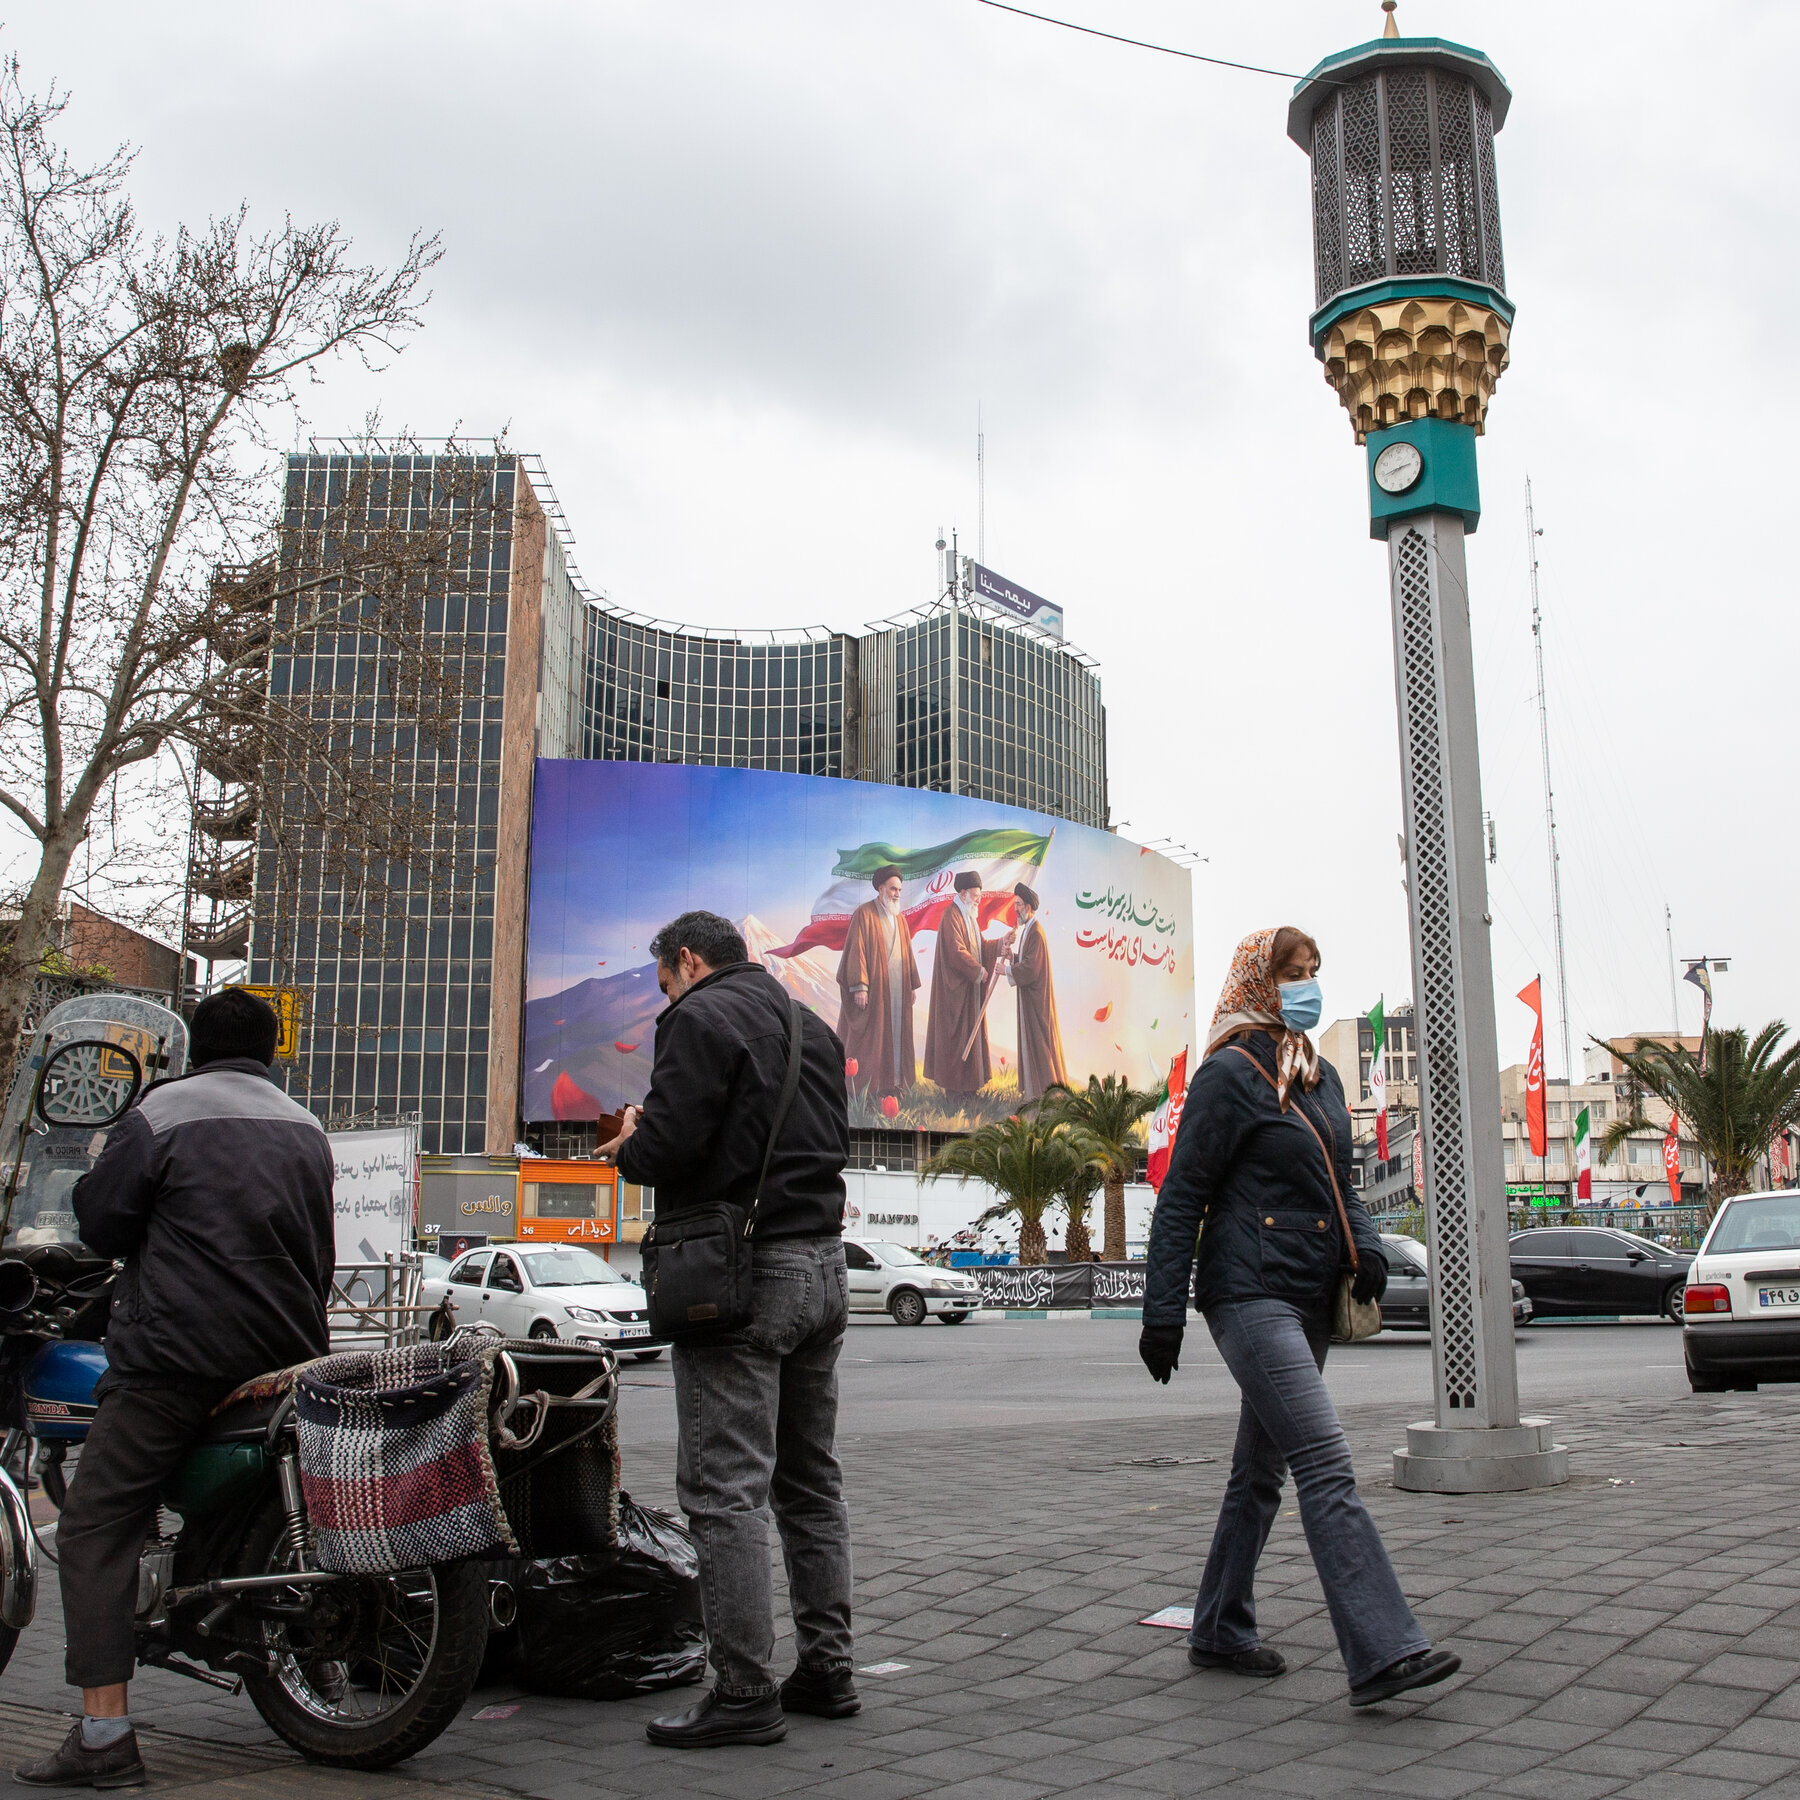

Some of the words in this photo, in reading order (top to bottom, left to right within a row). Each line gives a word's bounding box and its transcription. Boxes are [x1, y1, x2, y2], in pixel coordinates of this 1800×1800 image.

[980, 573, 1005, 597] سینا
[1005, 589, 1031, 613] بیمه
[1155, 916, 1176, 937] دست
[460, 1194, 513, 1217] والس
[424, 1224, 441, 1234] 37
[522, 1226, 534, 1235] 36
[567, 1219, 611, 1239] دیدار
